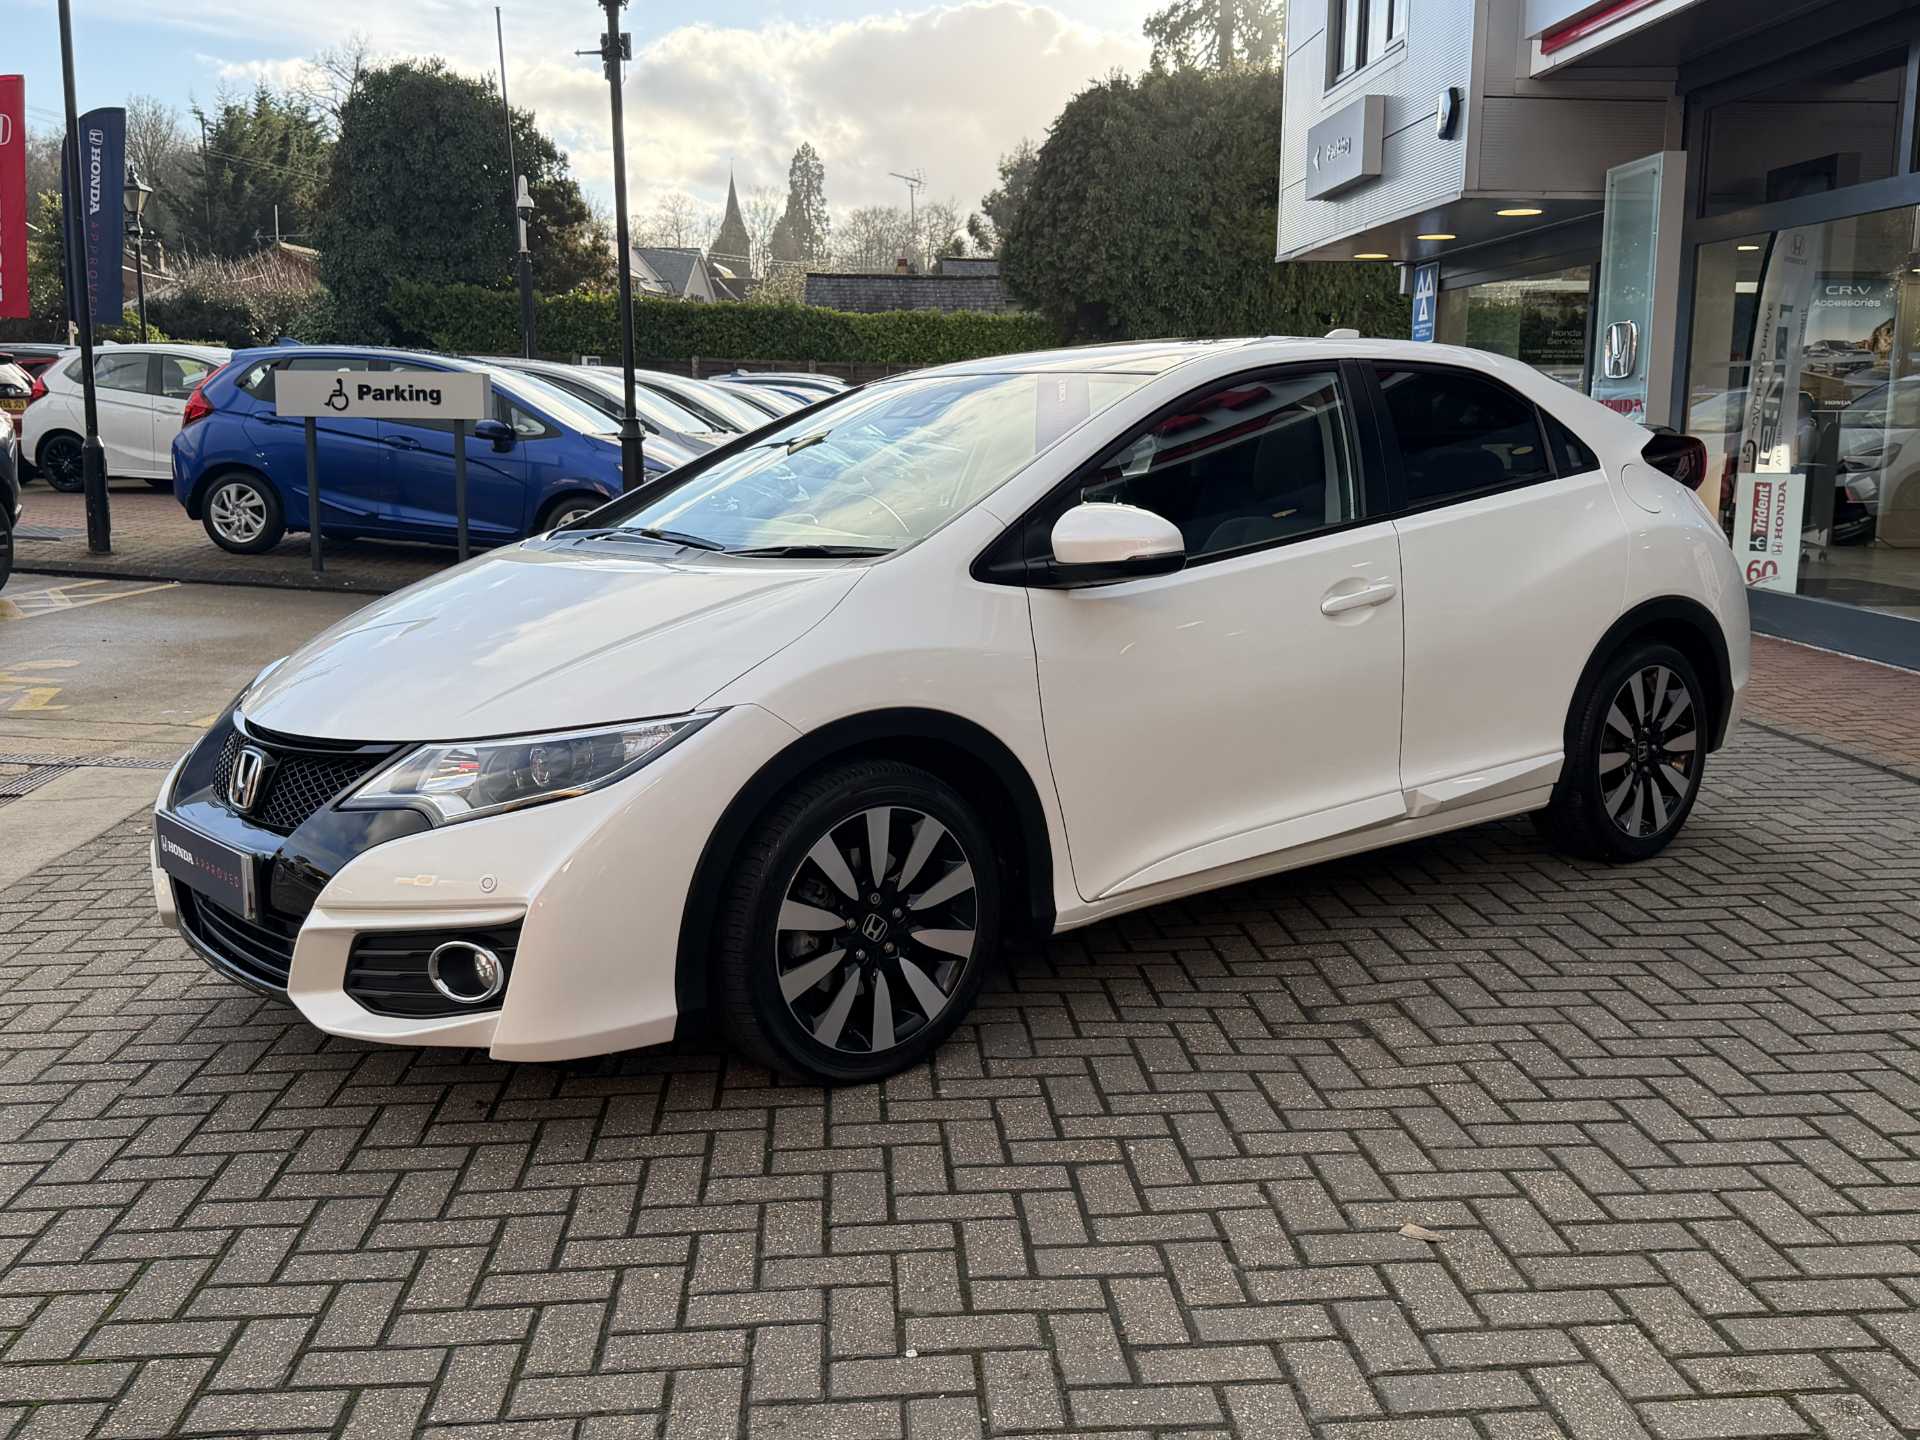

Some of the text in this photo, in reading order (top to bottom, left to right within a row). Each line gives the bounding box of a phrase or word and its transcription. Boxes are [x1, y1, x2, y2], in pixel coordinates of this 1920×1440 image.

[89, 147, 101, 215] HONDA
[1825, 285, 1872, 296] CR-V
[1812, 298, 1882, 308] Accessories
[1551, 329, 1583, 337] Honda
[356, 384, 442, 405] Parking
[1752, 485, 1771, 533] Trident
[1775, 480, 1787, 540] HONDA
[167, 840, 194, 865] HONDA
